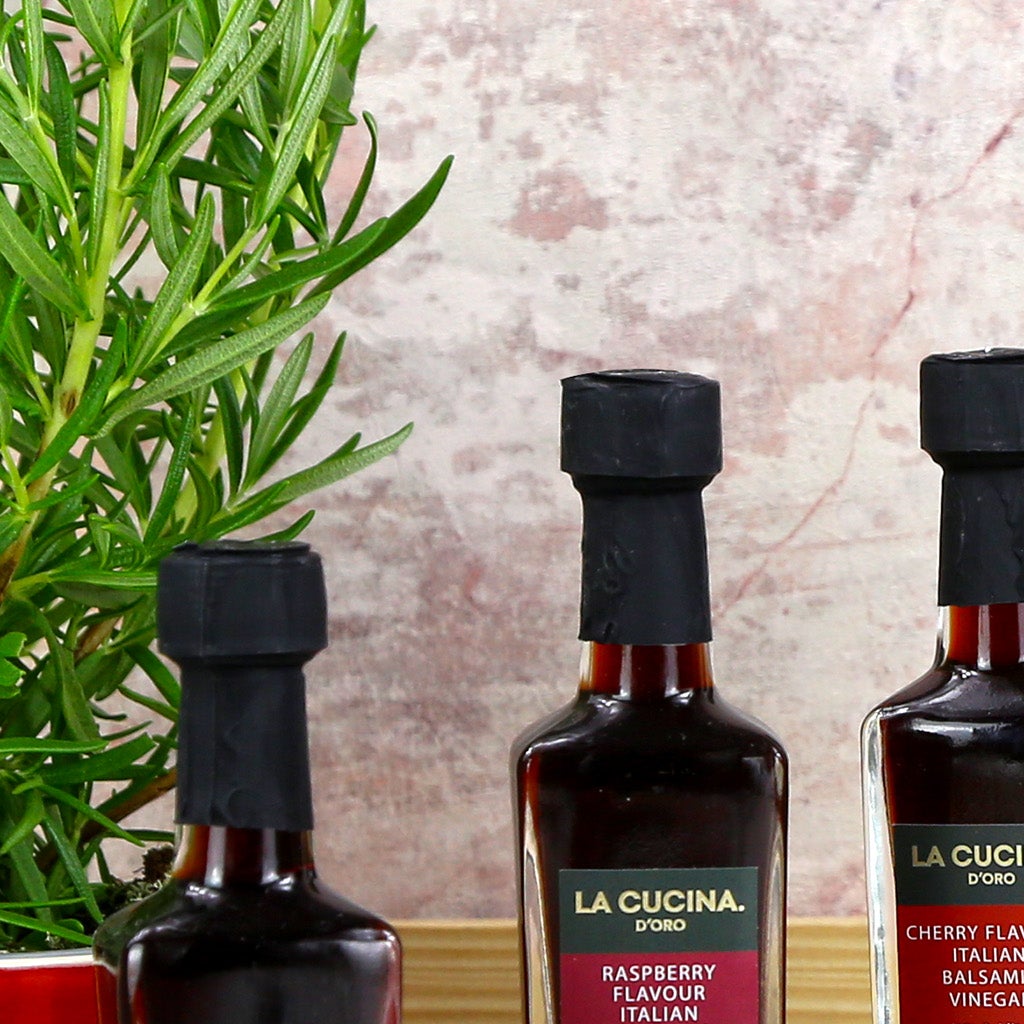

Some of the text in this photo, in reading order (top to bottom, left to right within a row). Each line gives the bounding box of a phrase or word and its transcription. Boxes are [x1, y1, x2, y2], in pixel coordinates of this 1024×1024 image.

[912, 845, 945, 867] LA
[575, 889, 745, 914] LA CUCINA.
[906, 925, 979, 940] CHERRY
[602, 964, 716, 981] RASPBERRY
[613, 985, 705, 1002] FLAVOUR
[620, 1006, 698, 1022] ITALIAN
